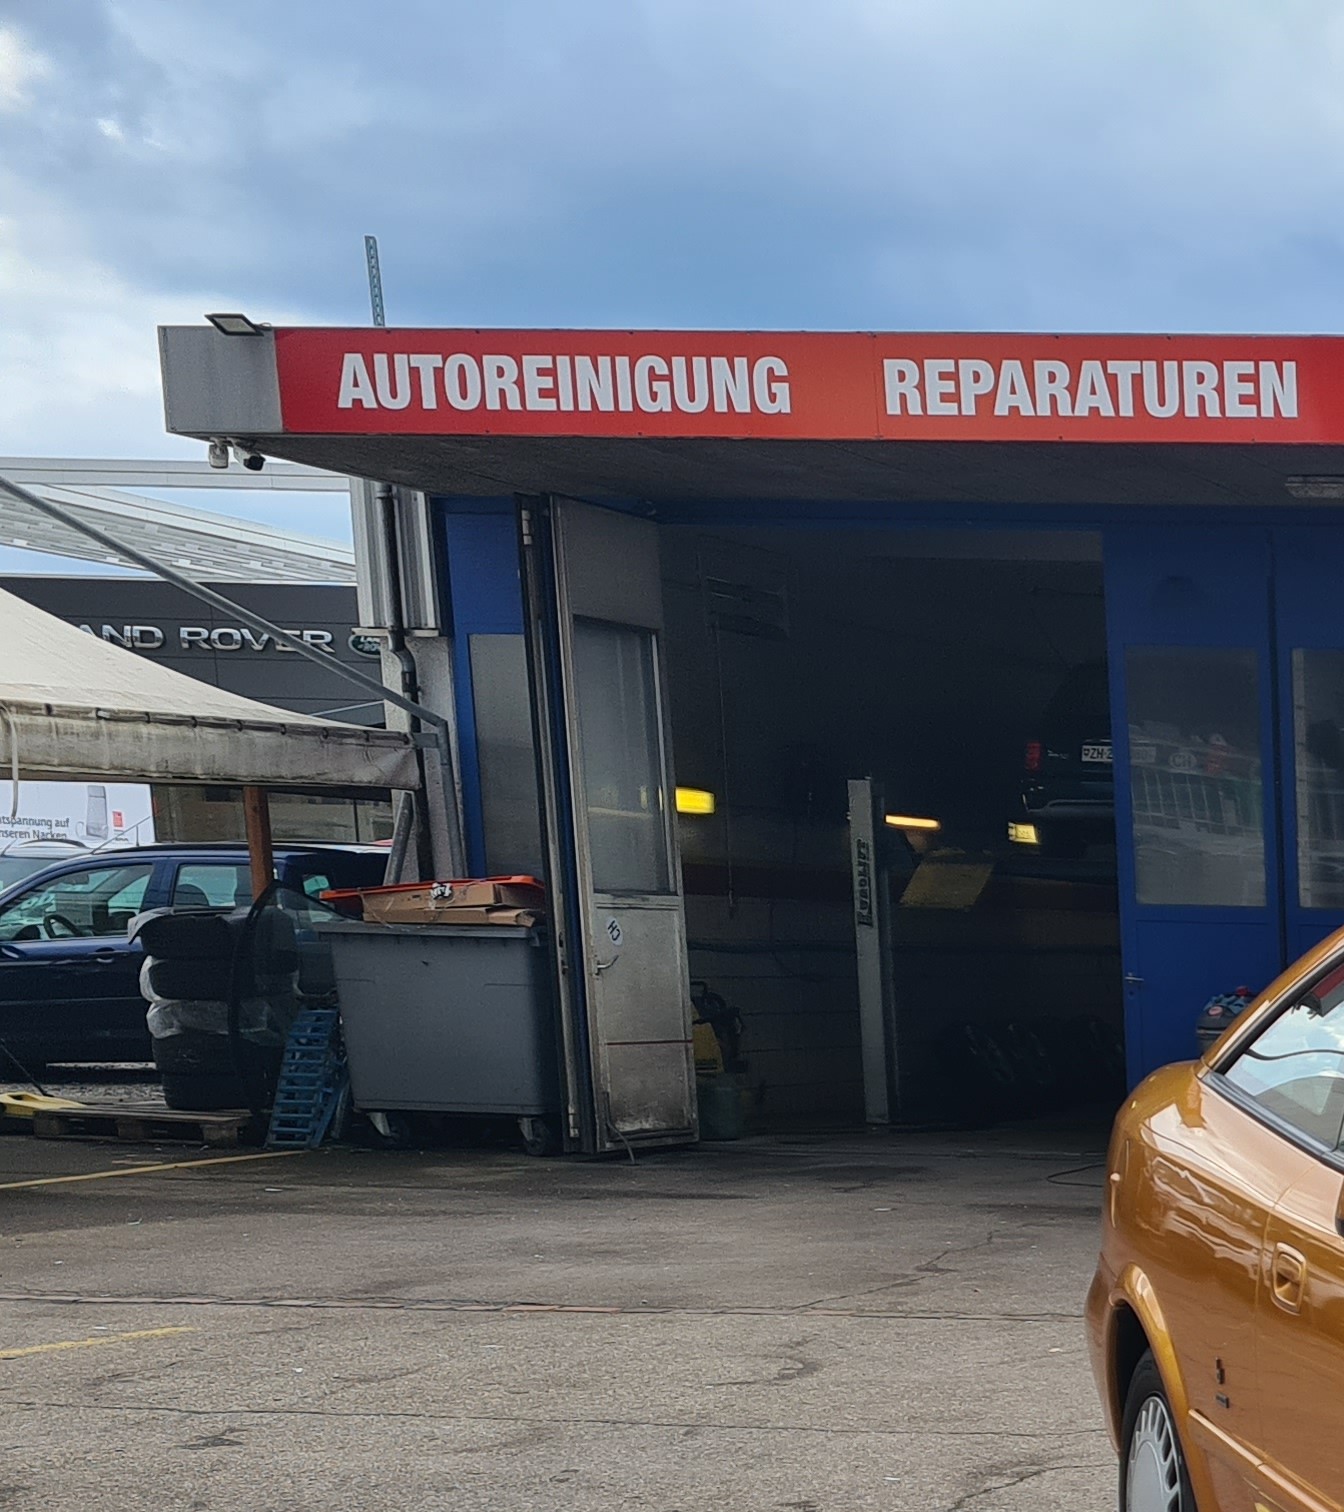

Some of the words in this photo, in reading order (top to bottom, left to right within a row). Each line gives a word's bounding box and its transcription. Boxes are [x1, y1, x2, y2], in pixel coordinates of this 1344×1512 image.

[337, 352, 792, 415] AUTOREINIGUNG
[883, 358, 1298, 418] REPARATUREN
[0, 816, 53, 830] tspannung
[54, 817, 70, 828] auf
